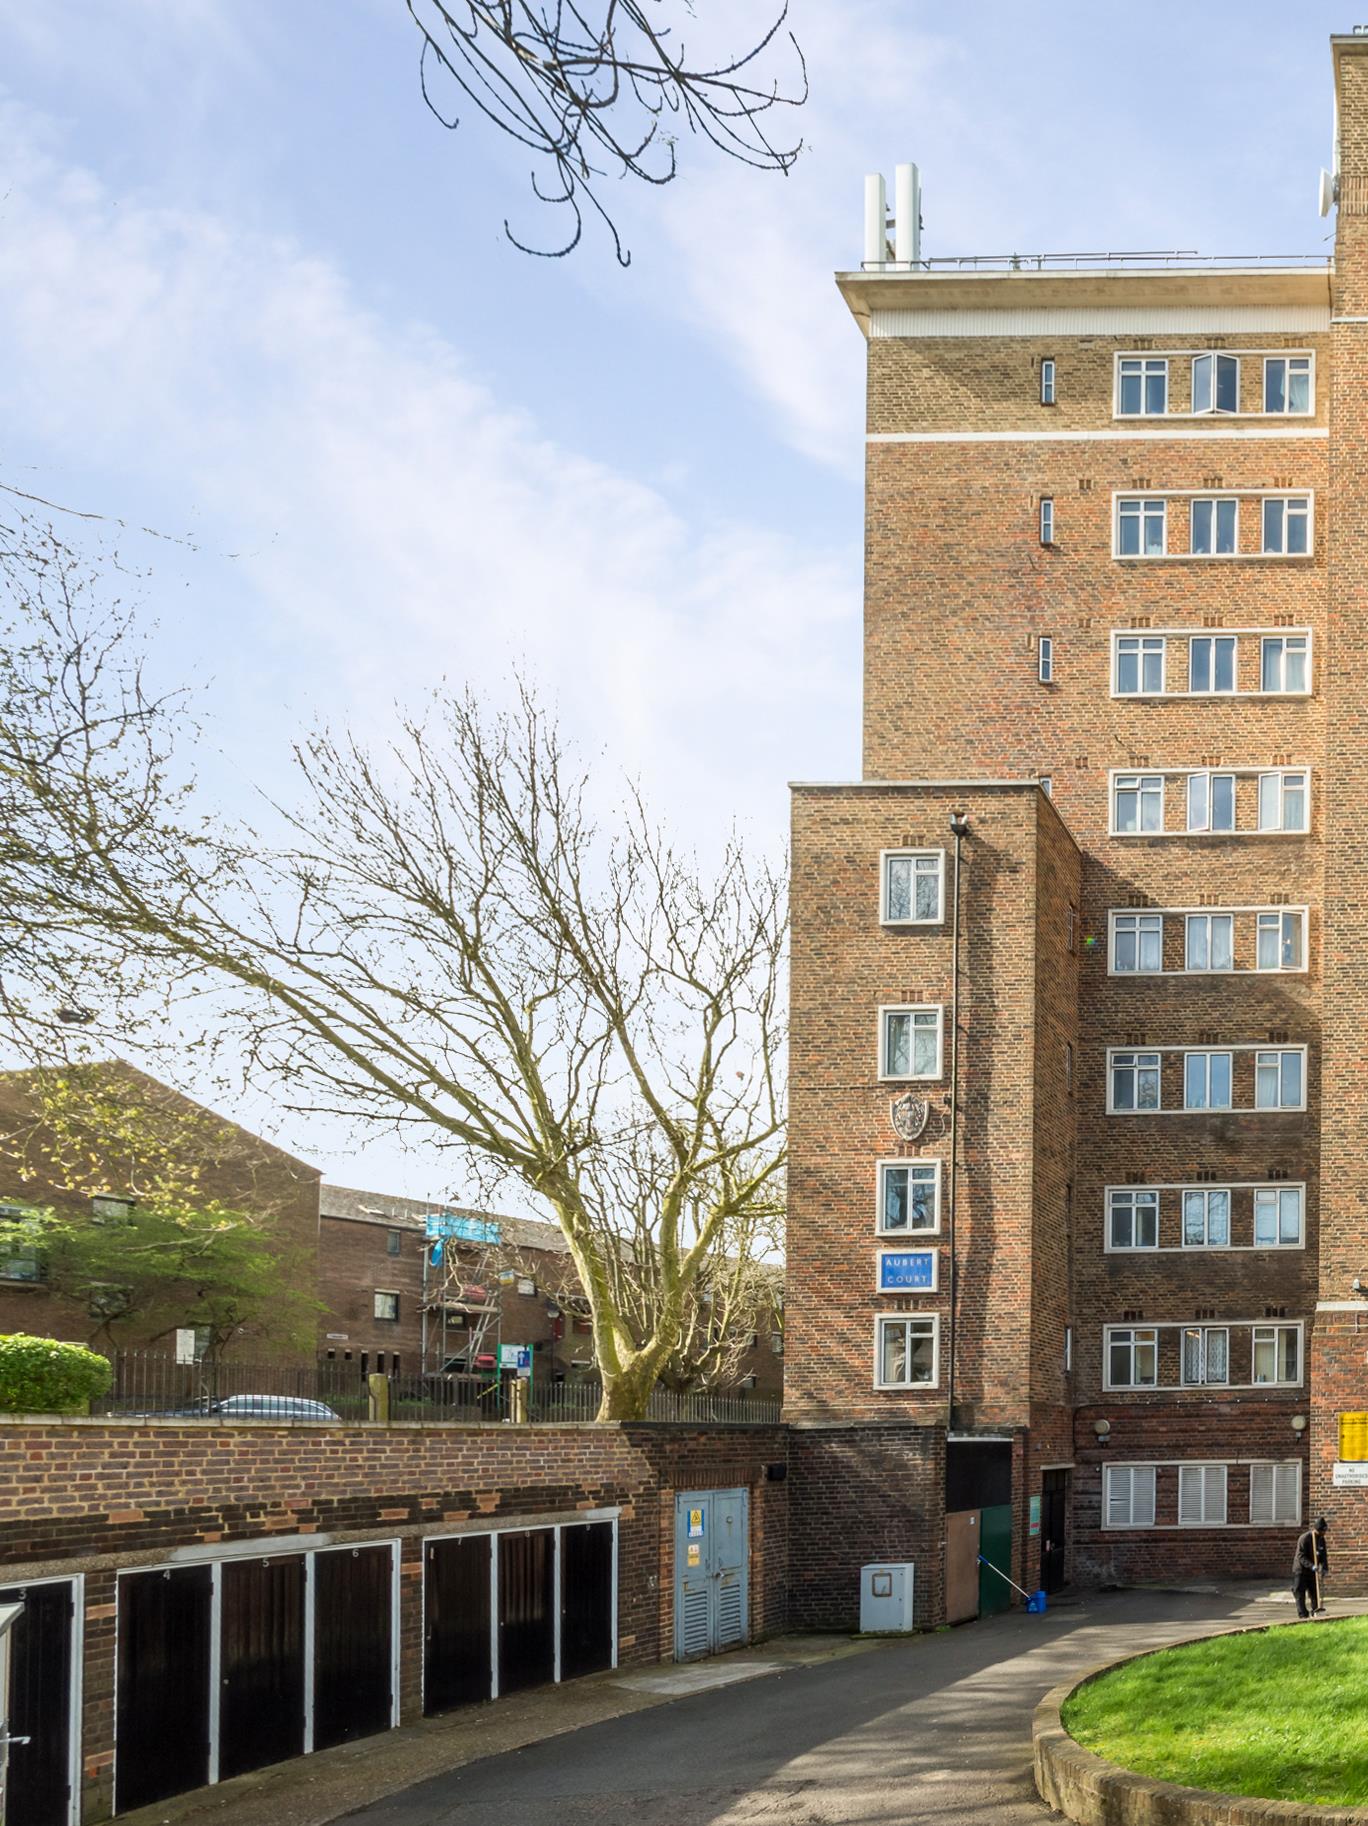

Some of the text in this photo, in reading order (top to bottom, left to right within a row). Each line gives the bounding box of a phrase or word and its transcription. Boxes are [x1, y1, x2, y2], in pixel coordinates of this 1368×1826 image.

[886, 1258, 929, 1267] AUBERT
[887, 1275, 927, 1284] COURT
[352, 1548, 360, 1558] 6
[262, 1556, 270, 1568] 5
[162, 1569, 171, 1580] 4
[18, 1587, 27, 1600] 3
